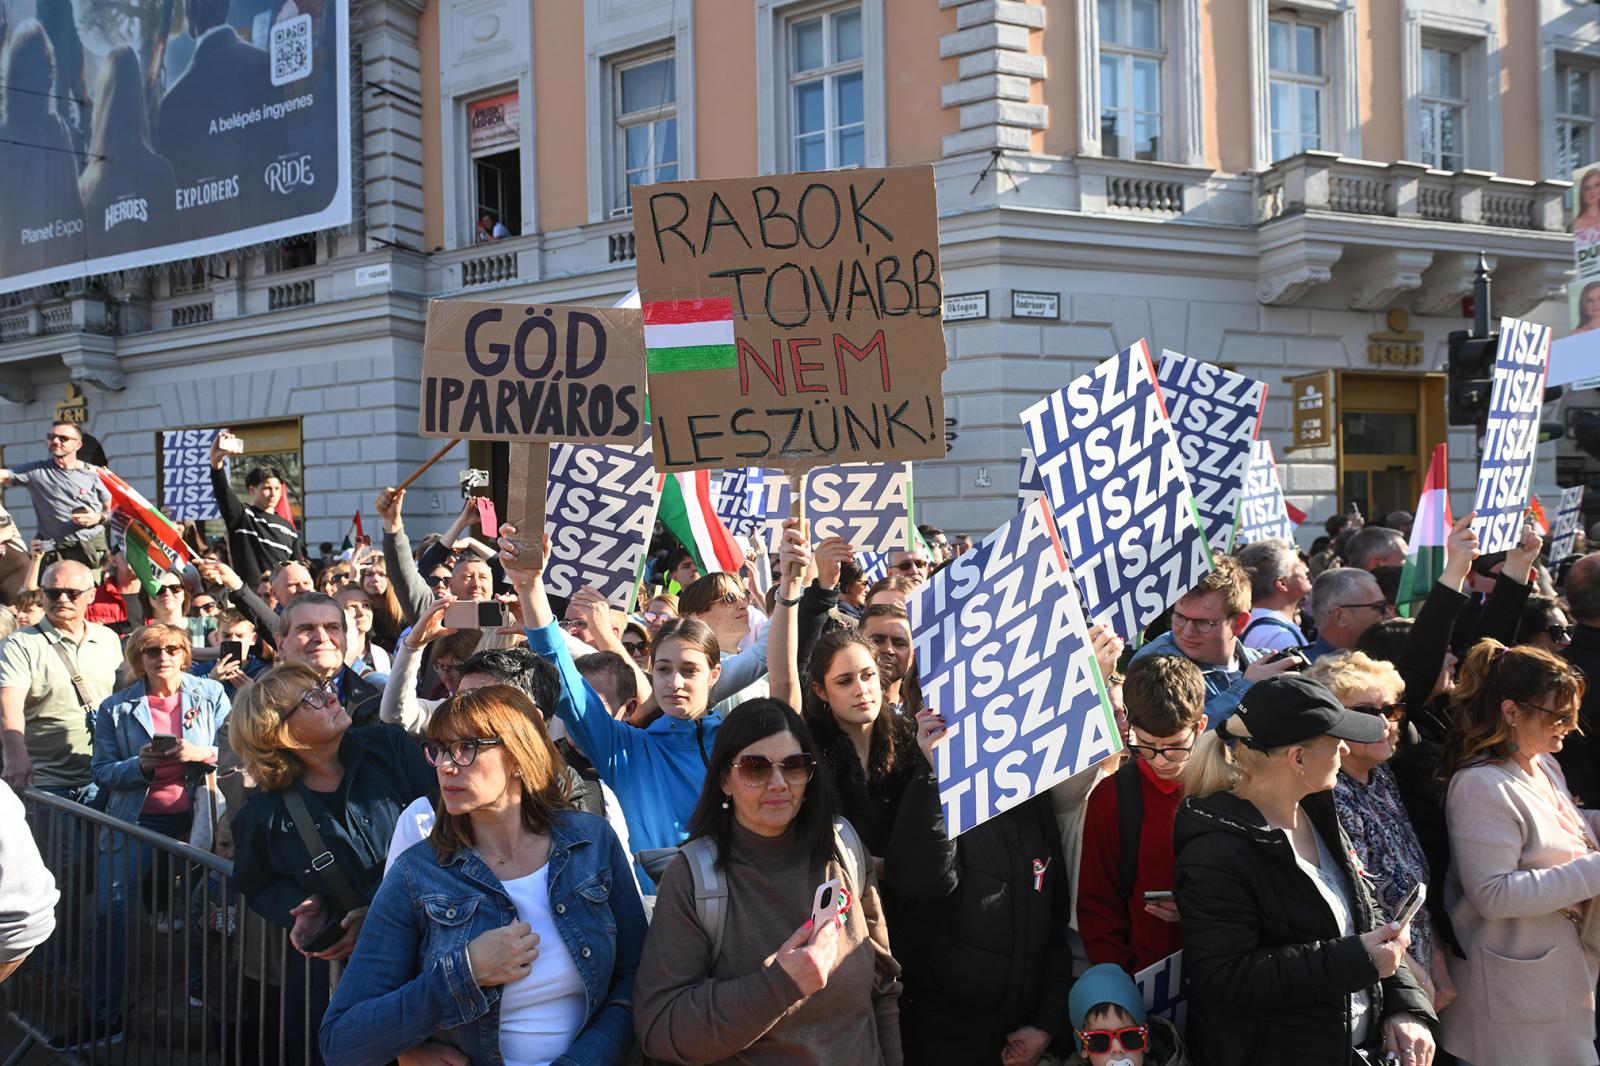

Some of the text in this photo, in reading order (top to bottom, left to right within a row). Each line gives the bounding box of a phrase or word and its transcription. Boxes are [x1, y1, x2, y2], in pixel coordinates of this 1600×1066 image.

[208, 93, 314, 134] A belépés ingyenes
[104, 198, 148, 231] HEROES
[175, 174, 239, 210] EXPLORERS
[21, 218, 84, 245] Planet Expo
[650, 178, 894, 264] RABOK
[708, 244, 941, 328] TOVÁBB
[947, 302, 978, 313] Oktogon
[464, 307, 607, 379] GÖD
[737, 329, 891, 397] NEM
[1368, 345, 1424, 364] K&H
[1498, 316, 1548, 366] TISZA
[425, 369, 639, 437] IPARVÁROS
[1020, 340, 1153, 458] TISZA
[1158, 349, 1265, 412] TISZA
[1491, 367, 1543, 413] TISZA
[53, 408, 84, 422] K&H
[163, 429, 226, 447] TISZ
[657, 395, 936, 466] LESZÜNK!
[1301, 429, 1321, 439] 0-24
[1302, 418, 1321, 430] ATM
[1484, 418, 1538, 460] TISZA
[163, 449, 226, 467] TISZ
[550, 443, 657, 496] ISZA
[1039, 391, 1170, 510] TISZA
[163, 467, 214, 485] TISZ
[163, 485, 217, 504] TISZ
[763, 472, 908, 513] TSZA
[1476, 465, 1531, 509] TISZA
[546, 481, 651, 538] ISZA
[1057, 440, 1185, 561] TISZA
[1240, 493, 1287, 529] TISZA
[764, 516, 910, 552] TSZA
[1074, 488, 1199, 610] TISZA
[905, 499, 1052, 633] TISZA
[912, 545, 1068, 680] TISZA
[921, 595, 1084, 714] TISZA
[931, 648, 1099, 784] TISZA
[940, 703, 1114, 841] TISZA
